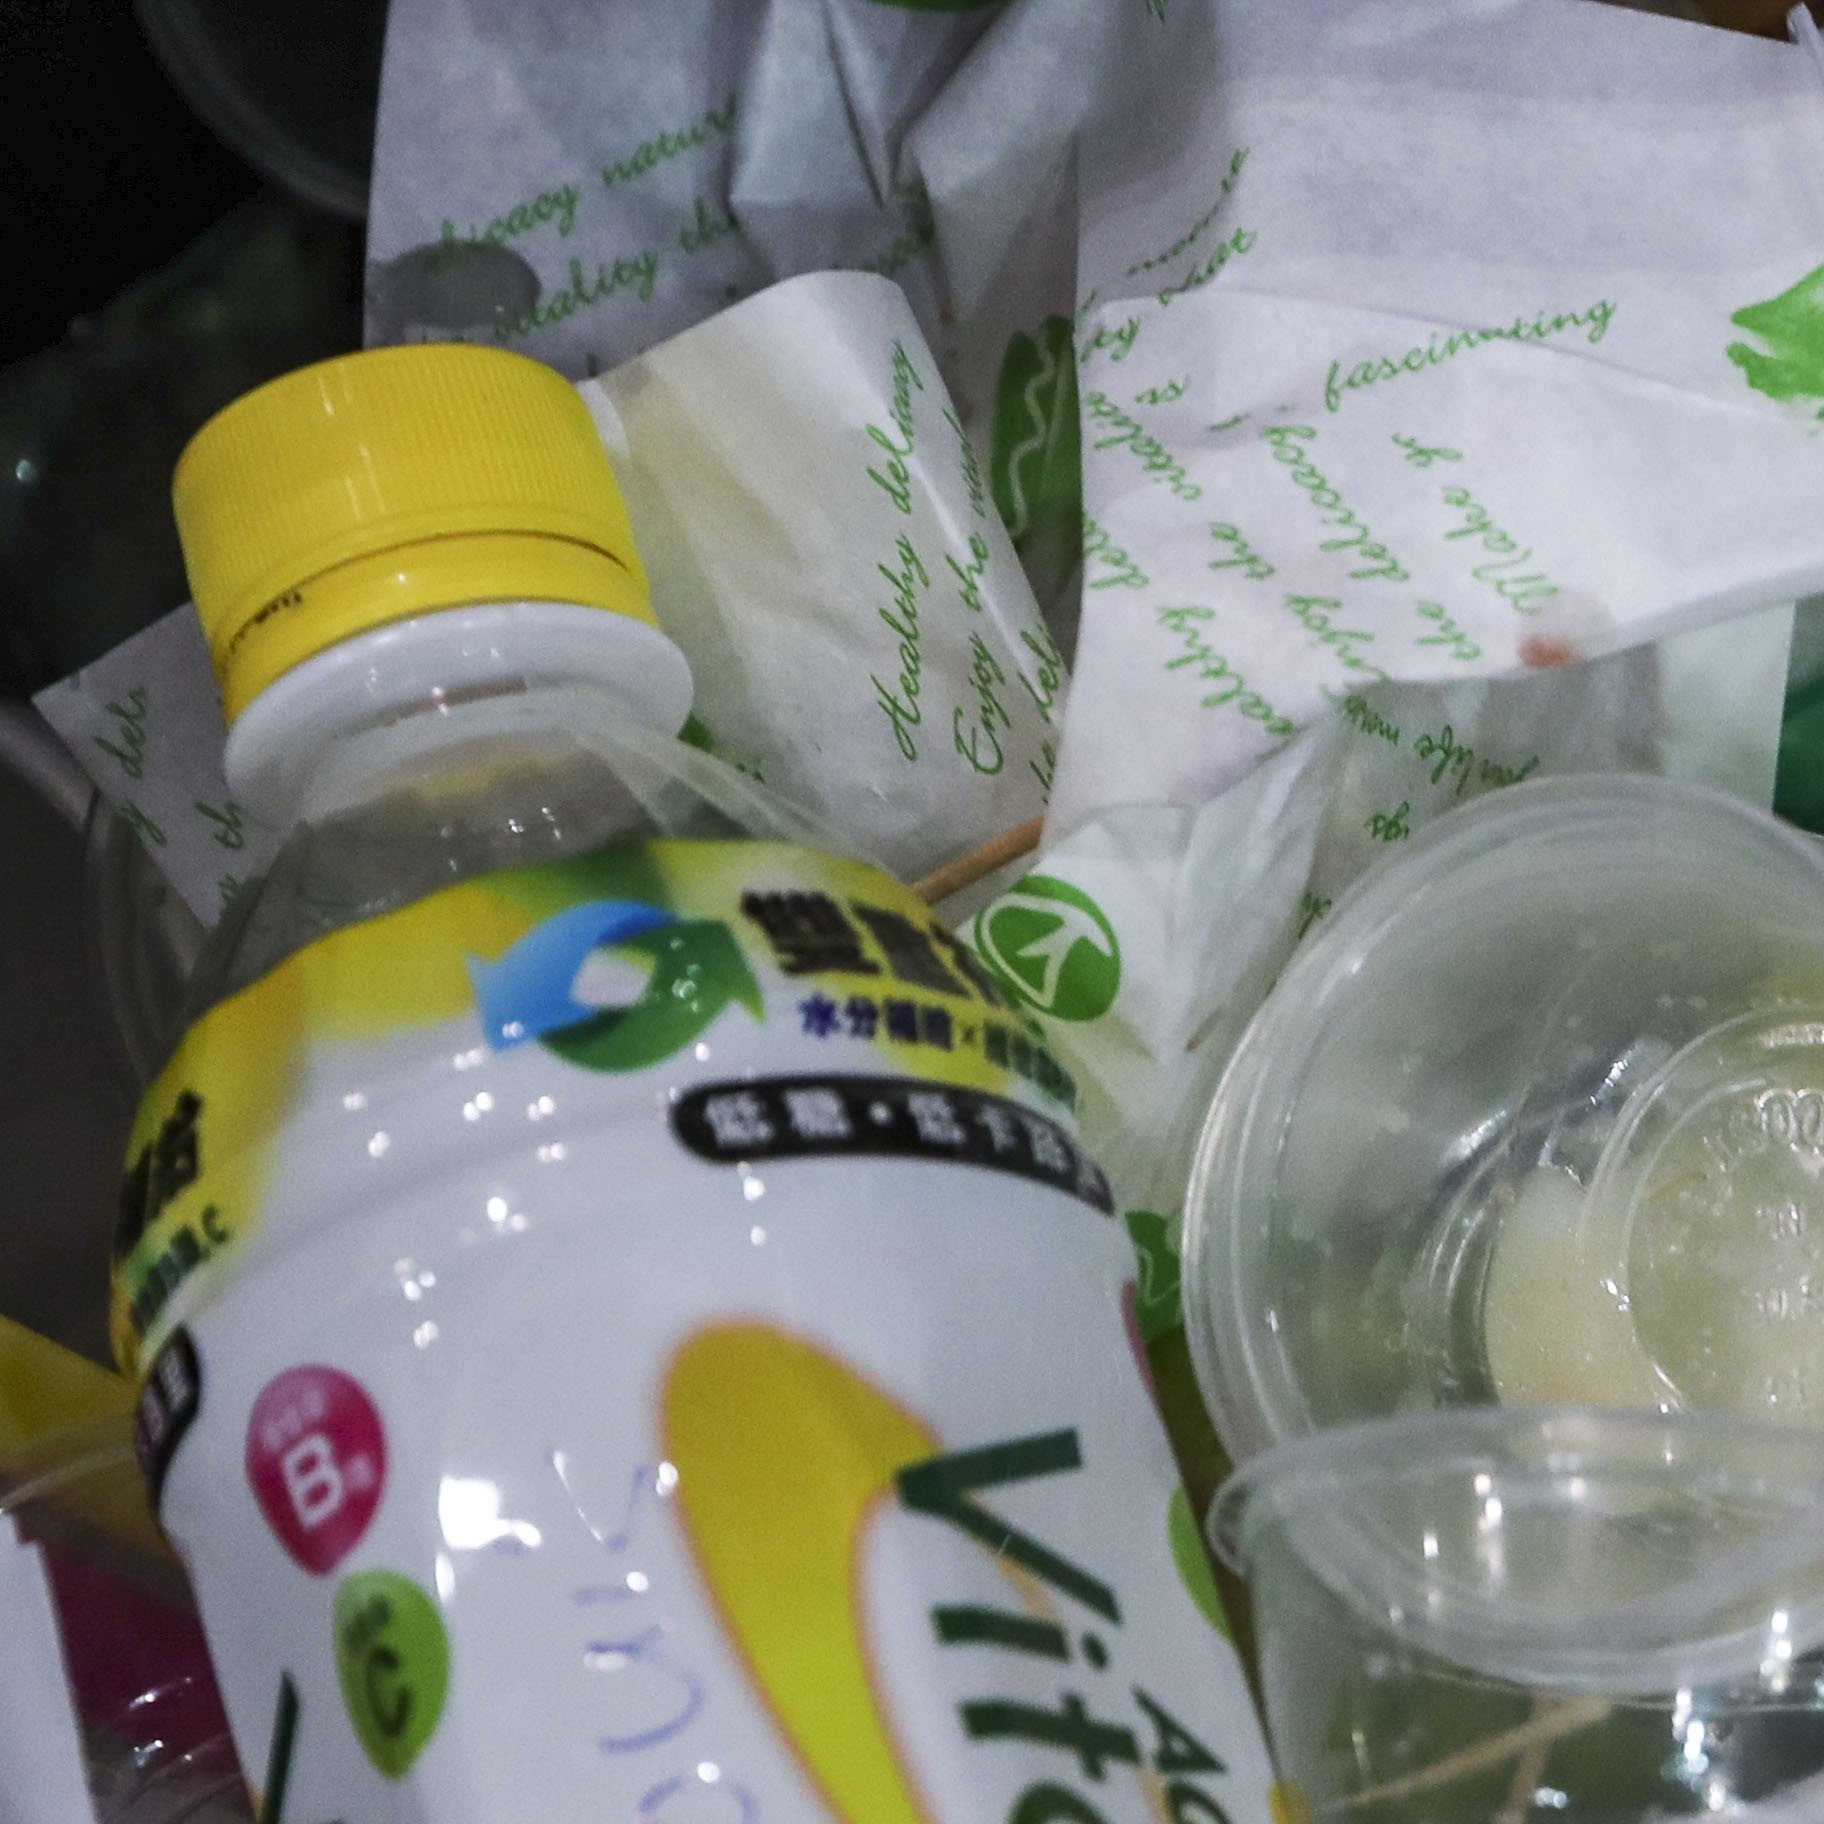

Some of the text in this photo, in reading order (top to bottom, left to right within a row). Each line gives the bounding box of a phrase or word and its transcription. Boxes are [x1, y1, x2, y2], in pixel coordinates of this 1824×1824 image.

[946, 532, 990, 612] the
[869, 534, 931, 763] Healthy
[953, 630, 1010, 776] Enjoy
